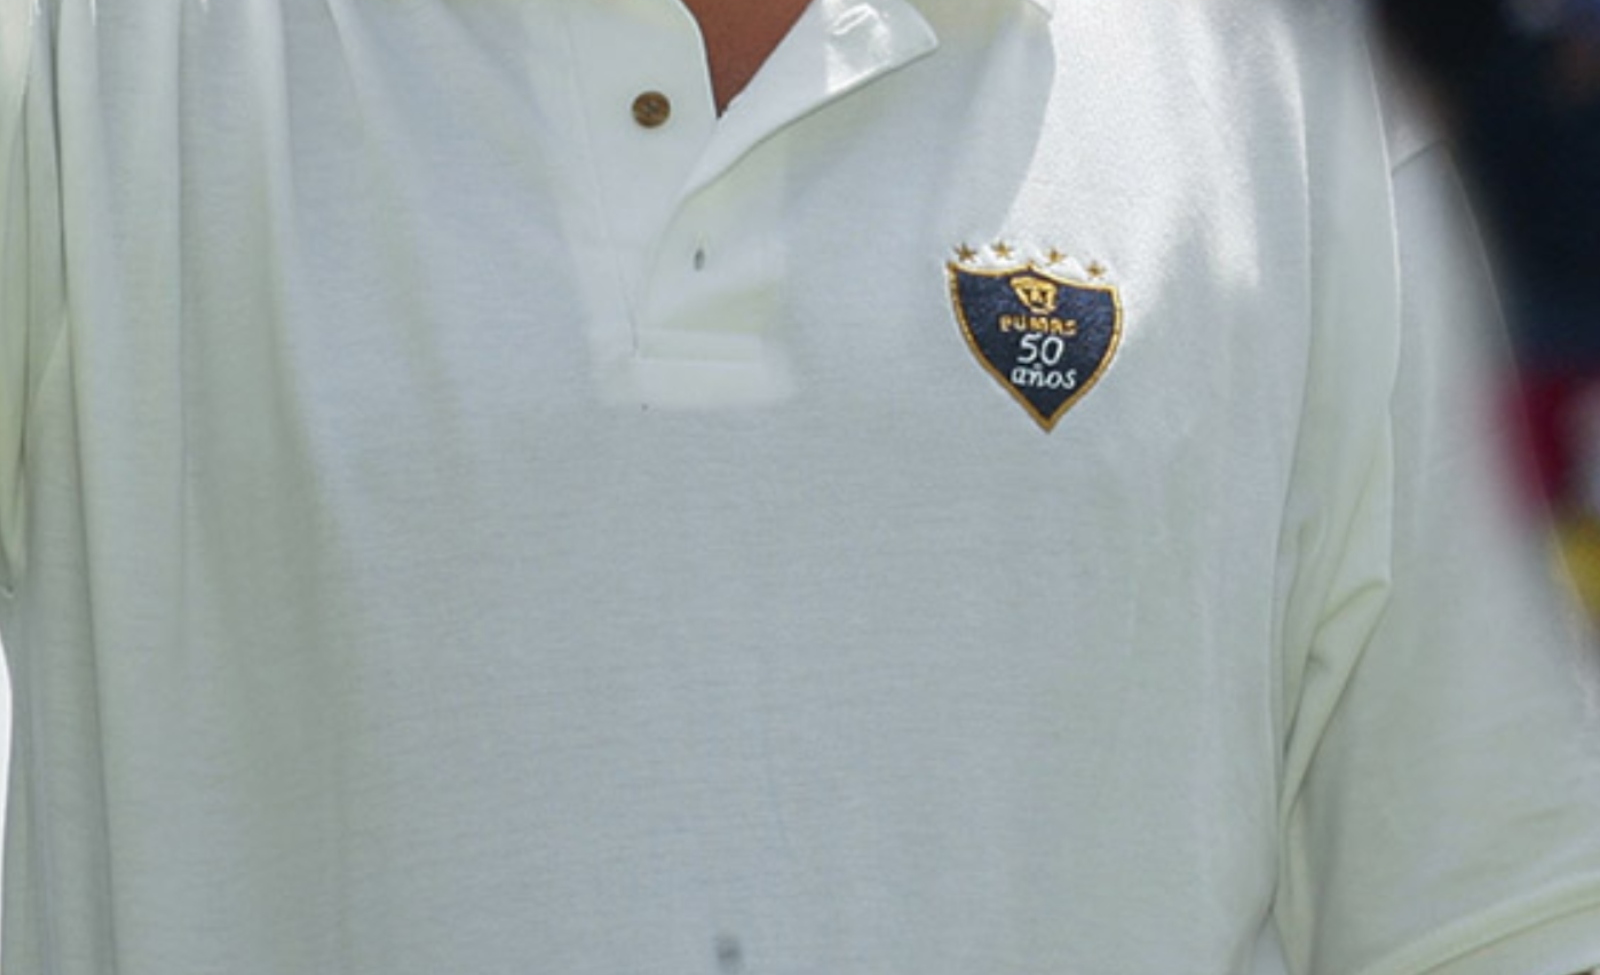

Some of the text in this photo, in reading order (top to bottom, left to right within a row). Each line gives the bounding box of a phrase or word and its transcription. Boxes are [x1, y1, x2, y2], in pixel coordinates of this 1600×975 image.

[1000, 315, 1077, 335] PUMAS
[1017, 332, 1064, 366] 50
[1011, 363, 1076, 389] años
